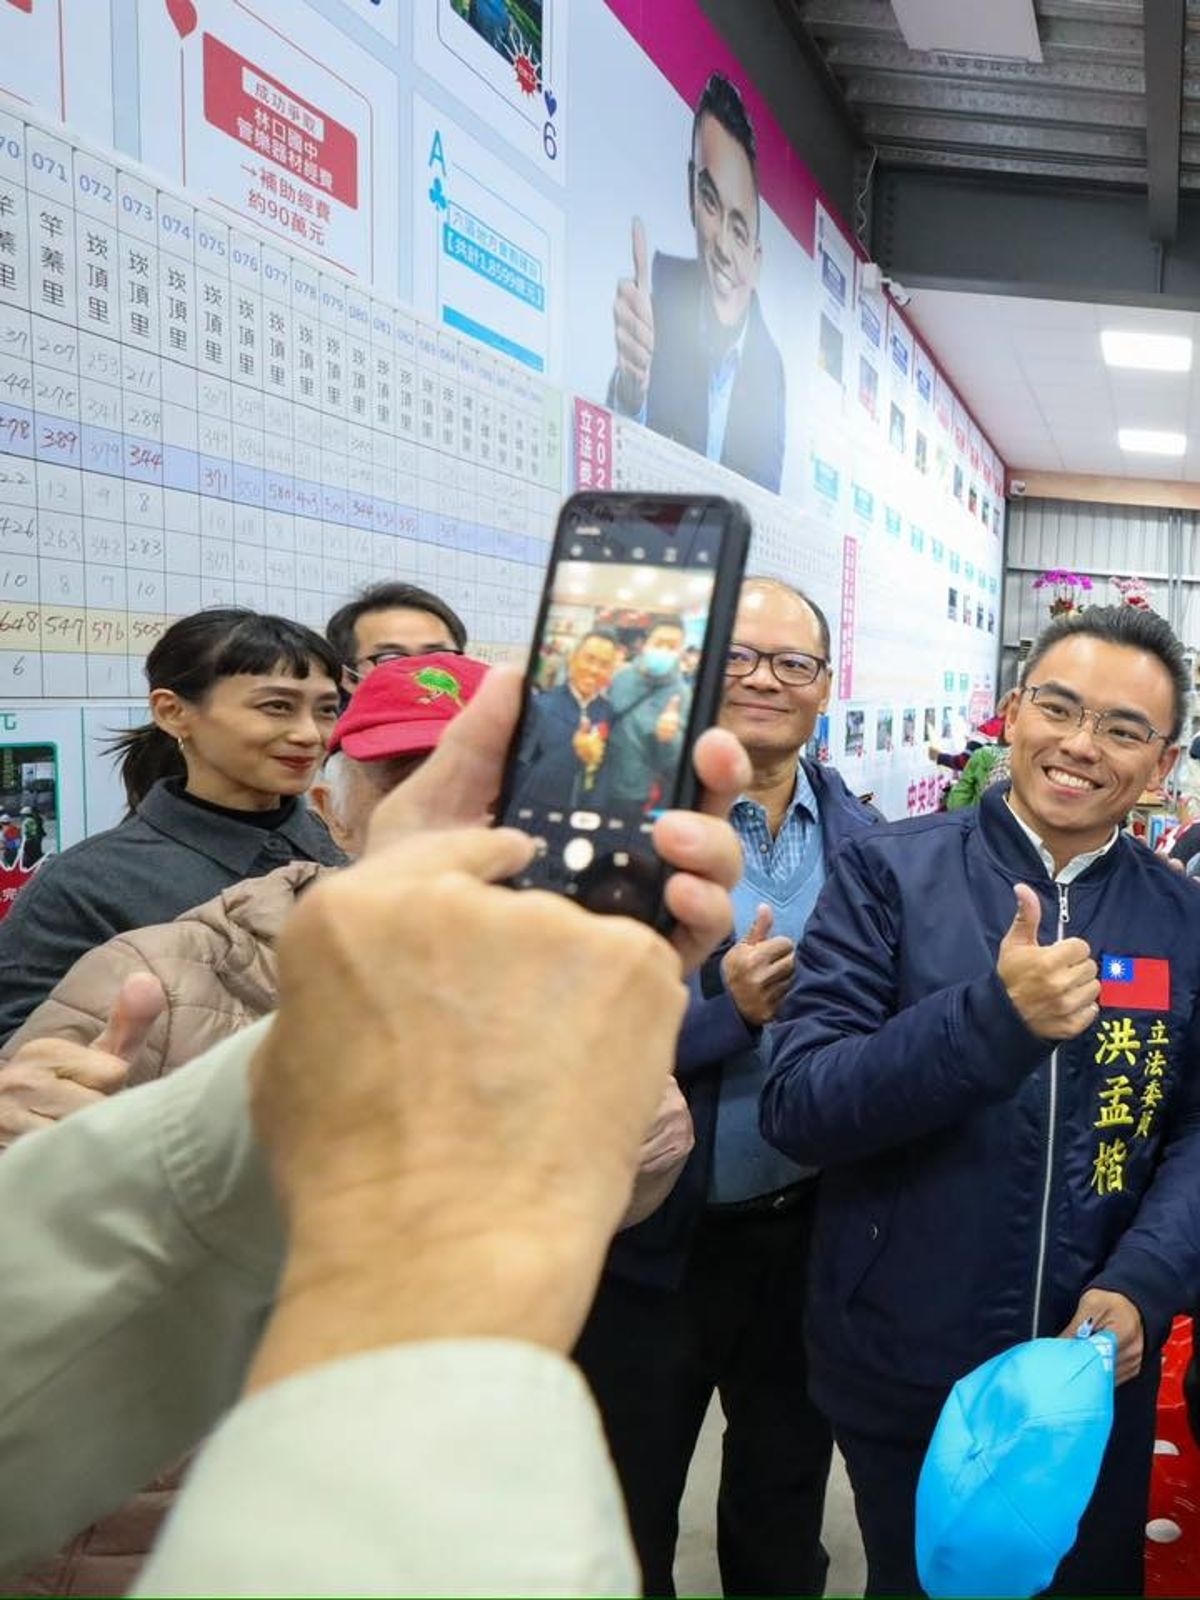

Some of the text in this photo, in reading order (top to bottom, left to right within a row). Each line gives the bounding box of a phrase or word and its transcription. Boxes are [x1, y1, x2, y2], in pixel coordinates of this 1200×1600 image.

[428, 129, 447, 177] A
[32, 152, 67, 183] 071
[79, 174, 112, 202] 072
[122, 195, 152, 221] 073
[162, 214, 191, 240] 074
[200, 232, 225, 256] 075
[232, 250, 258, 272] 076
[265, 264, 288, 285] 077
[86, 232, 110, 324] 崁頂里
[294, 279, 318, 299] 078
[129, 249, 150, 338] 崁頂里
[322, 292, 345, 312] 079
[168, 266, 188, 351] 崁頂里
[203, 283, 224, 364] 崁頂里
[238, 298, 255, 376] 崁頂里
[40, 340, 75, 361] 207
[269, 312, 286, 387] 崁頂里
[127, 366, 155, 388] 211
[40, 427, 78, 454] 389
[45, 615, 84, 645] 547
[12, 656, 25, 676] 6
[1133, 1019, 1170, 1138] 立法委員
[1091, 1018, 1141, 1196] 洪孟楷
